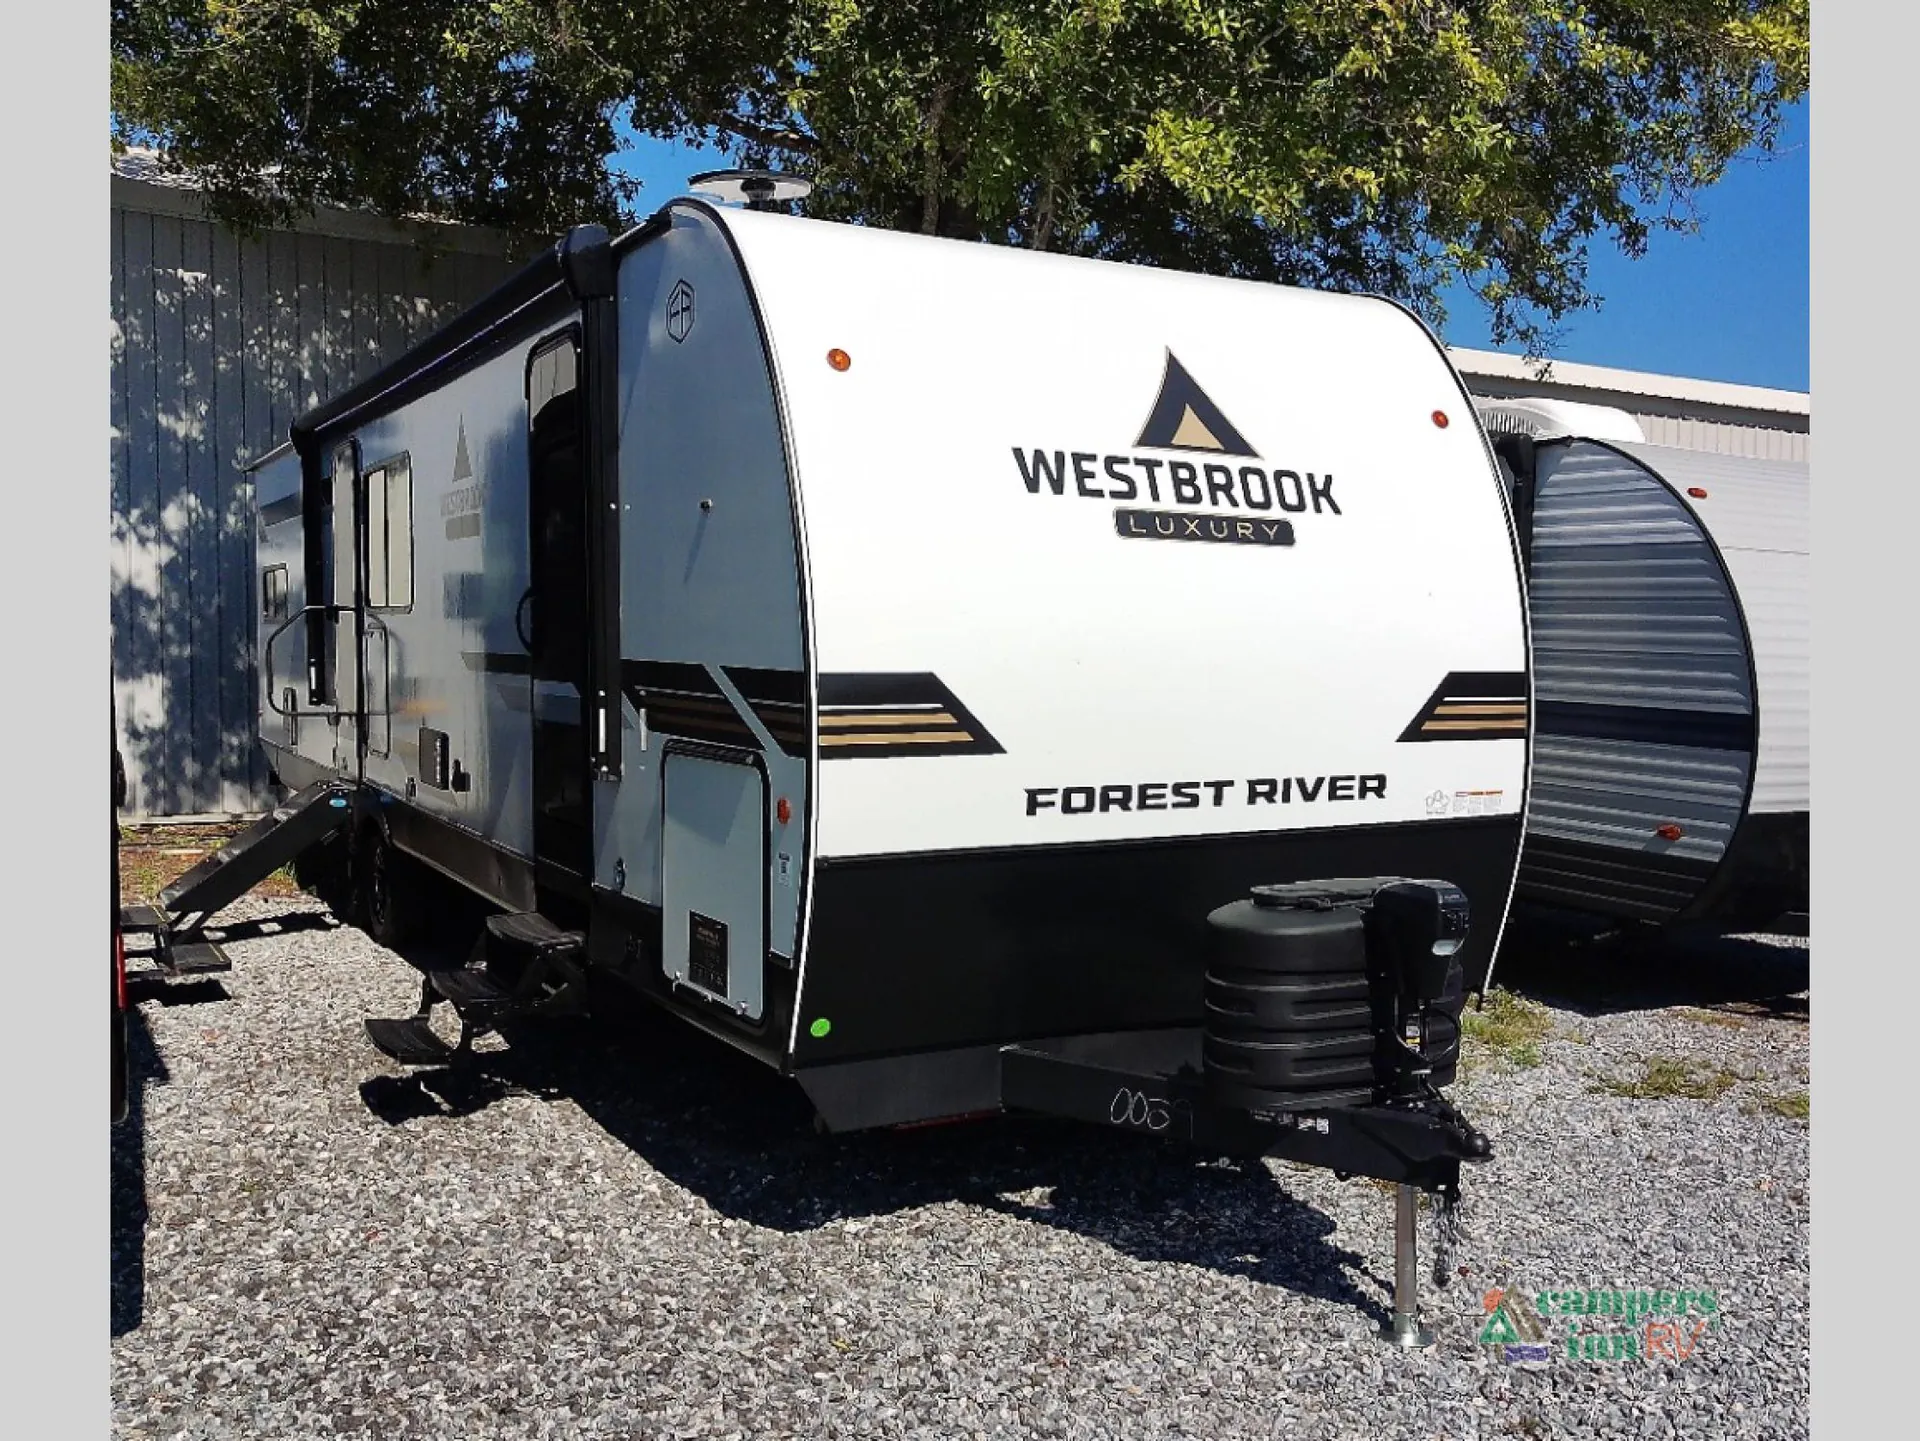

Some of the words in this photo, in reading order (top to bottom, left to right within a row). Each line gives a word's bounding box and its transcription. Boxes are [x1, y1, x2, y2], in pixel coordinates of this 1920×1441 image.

[1011, 446, 1342, 515] WESTBROOK
[1129, 513, 1281, 541] LUXURY
[1025, 780, 1234, 816] FOREST
[1247, 774, 1387, 804] RIVER
